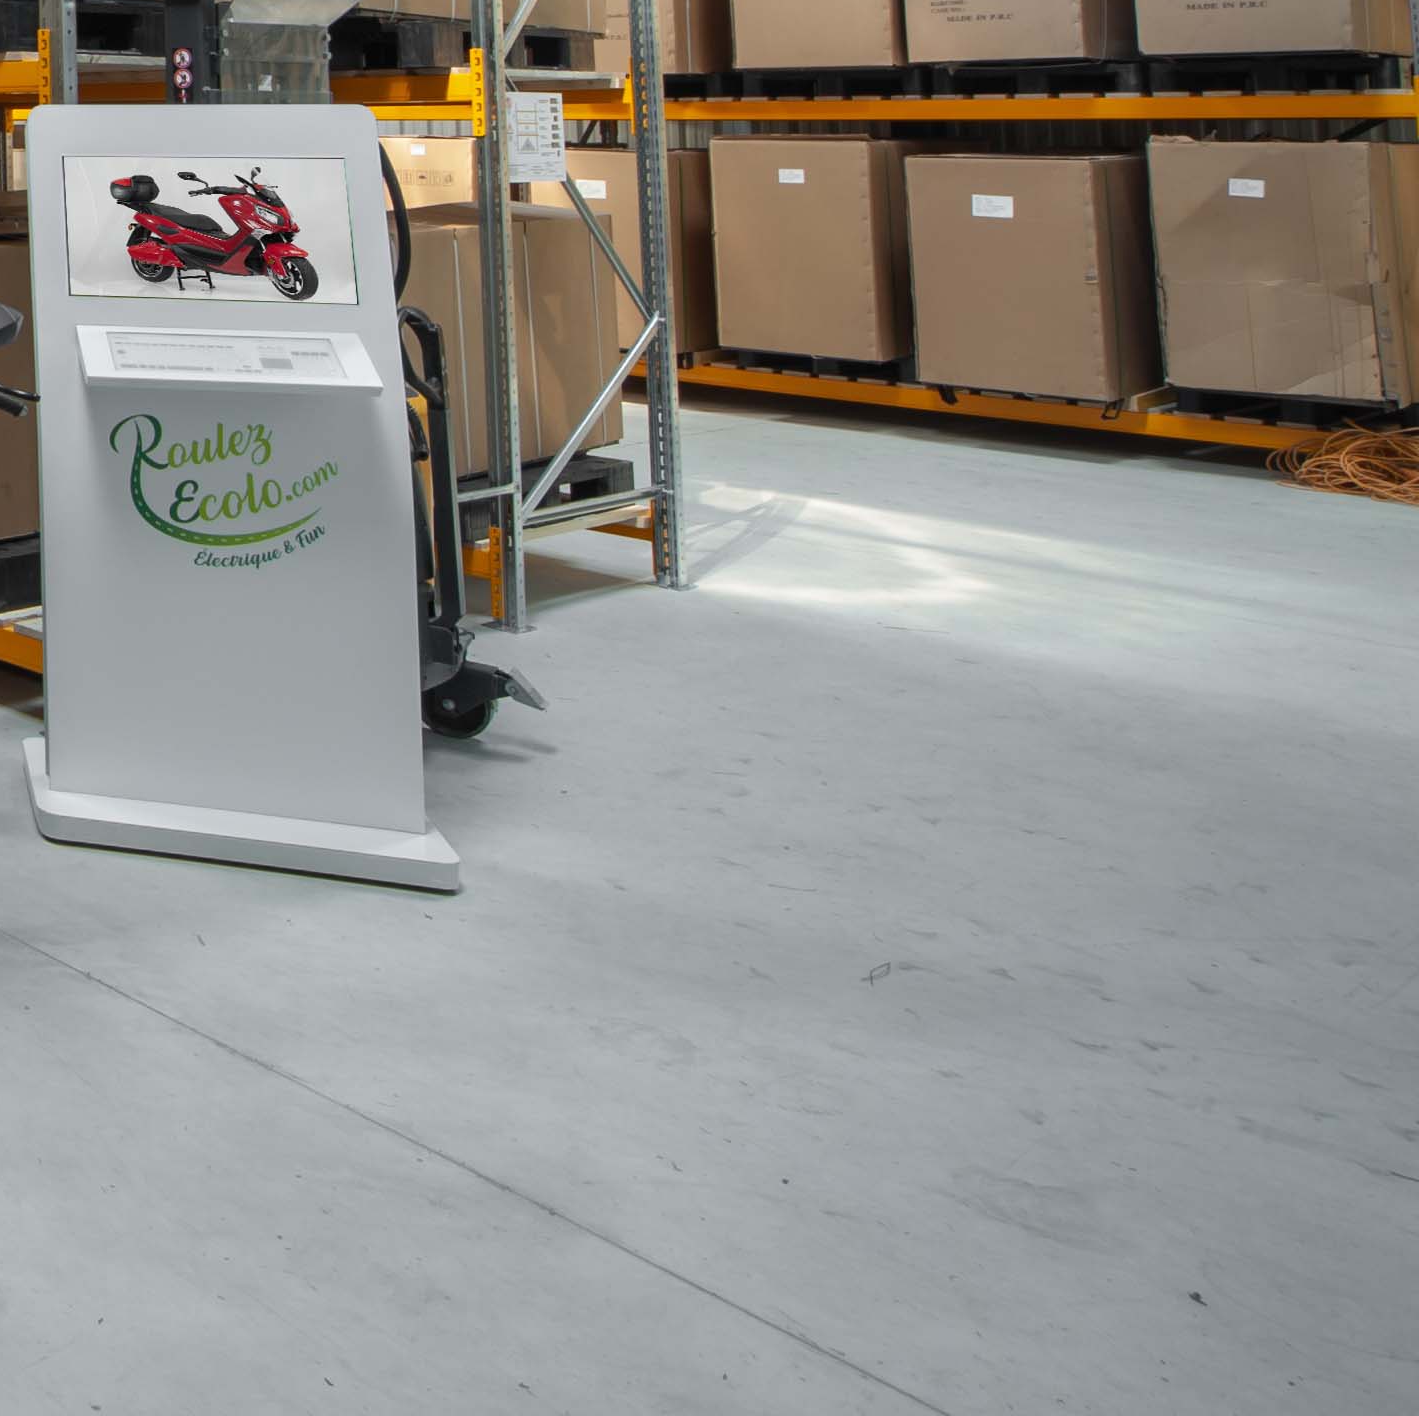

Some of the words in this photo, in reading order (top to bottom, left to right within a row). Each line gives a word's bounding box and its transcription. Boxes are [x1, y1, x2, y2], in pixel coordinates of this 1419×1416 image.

[1186, 2, 1218, 10] MADE
[110, 414, 273, 471] Roulez
[169, 460, 339, 524] Ecolo.com
[284, 541, 295, 554] &
[295, 526, 325, 549] Fun
